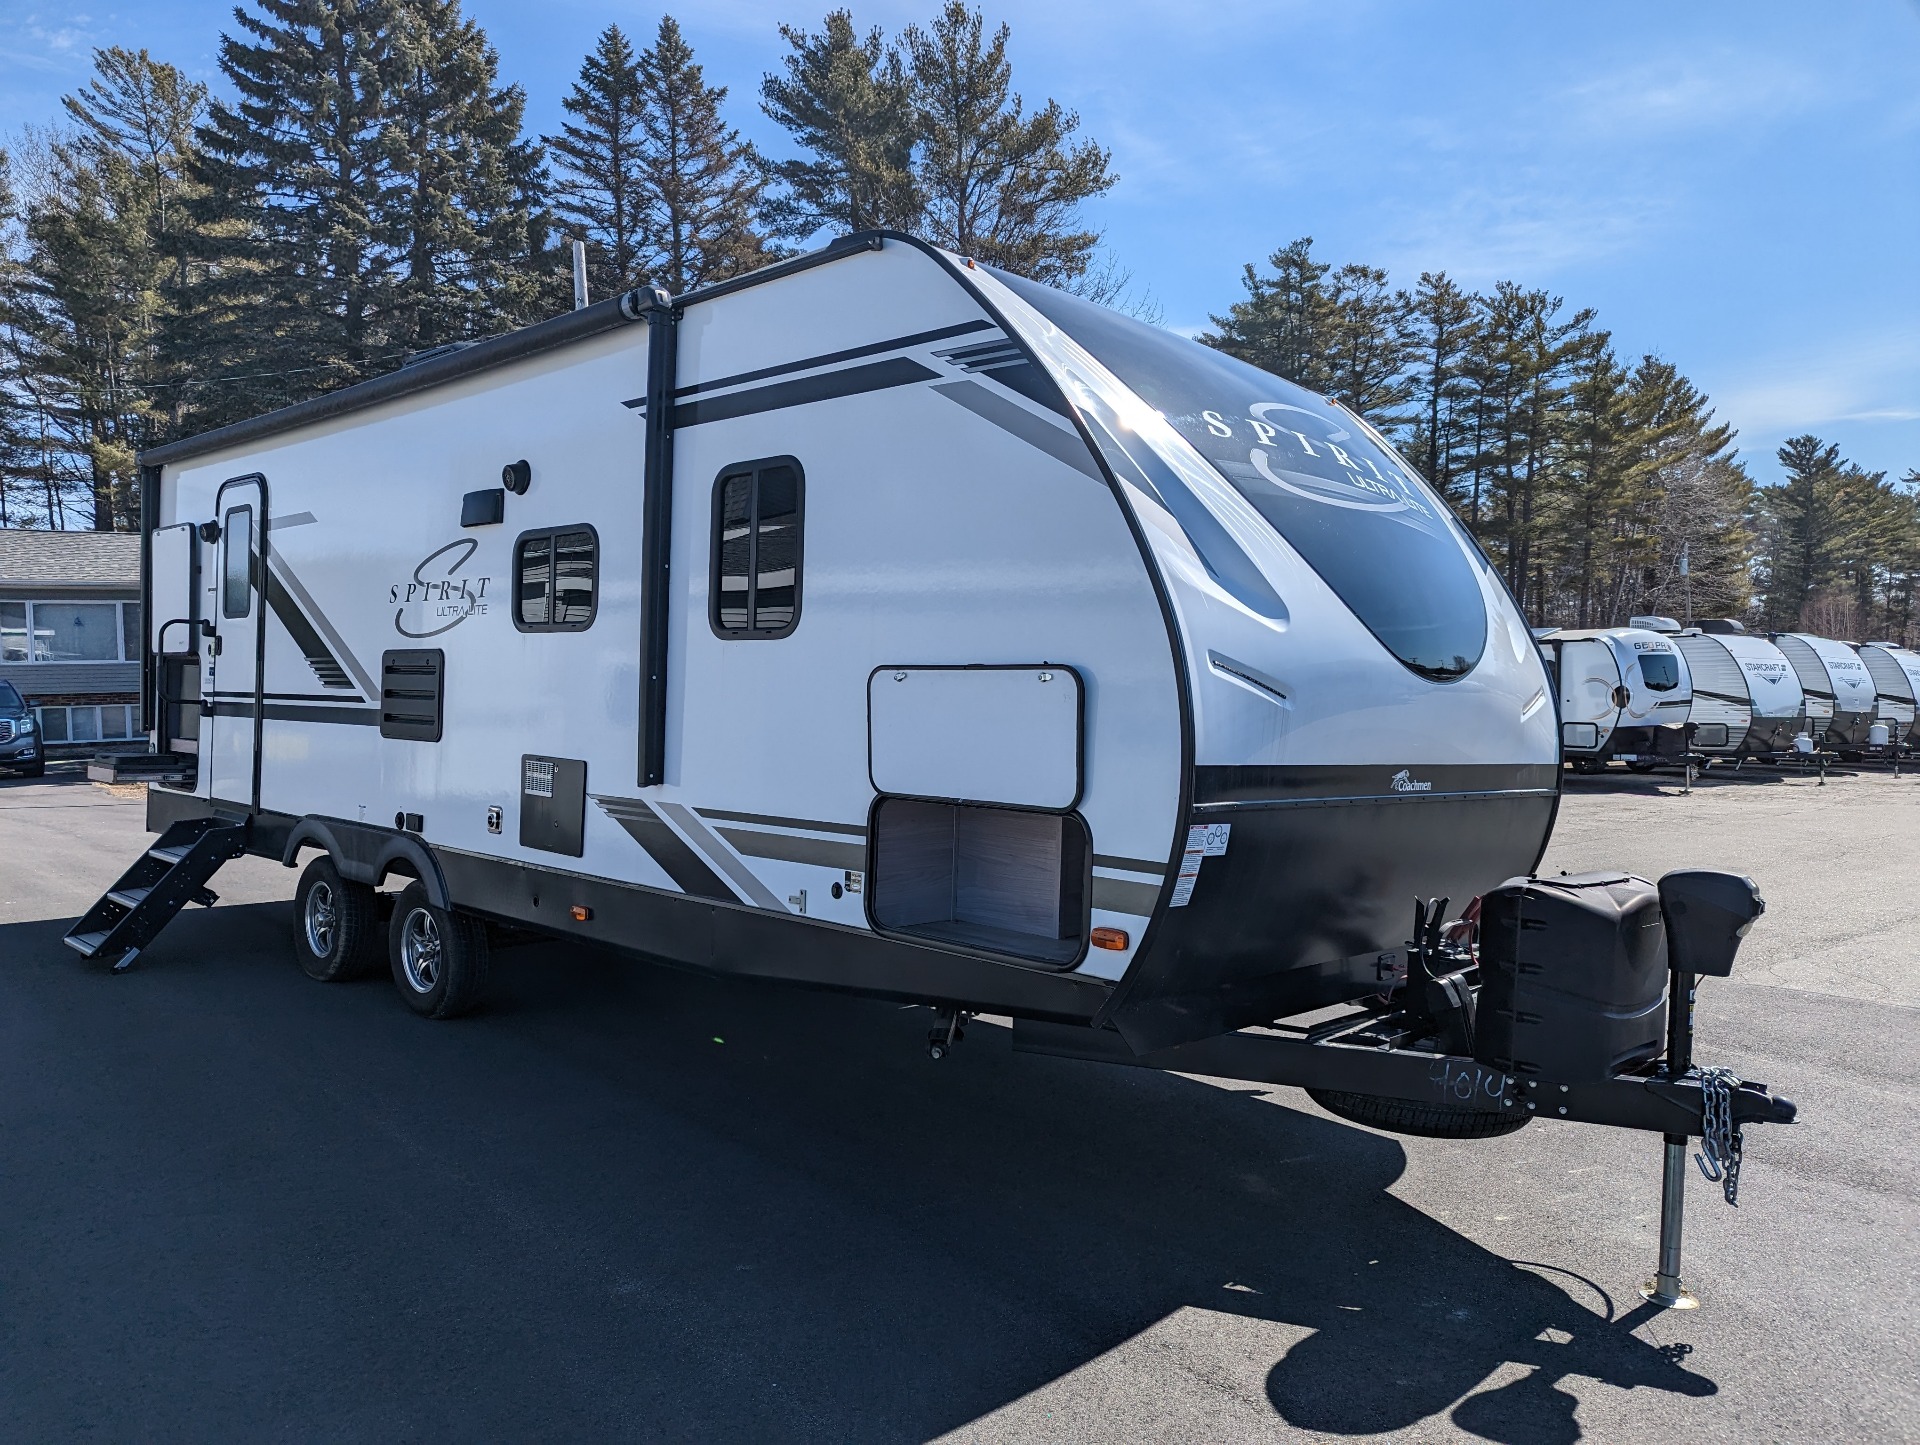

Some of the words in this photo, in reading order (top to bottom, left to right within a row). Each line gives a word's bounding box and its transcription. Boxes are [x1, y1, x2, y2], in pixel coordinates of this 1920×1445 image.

[1202, 410, 1415, 497] SPIRIT
[1347, 472, 1404, 503] ULTRA
[389, 577, 491, 604] SPIRIT
[436, 606, 465, 617] ULTRA
[1745, 663, 1781, 671] STARCRAFT
[1828, 662, 1858, 670] STARCRAFT
[1398, 780, 1432, 791] Coachmen
